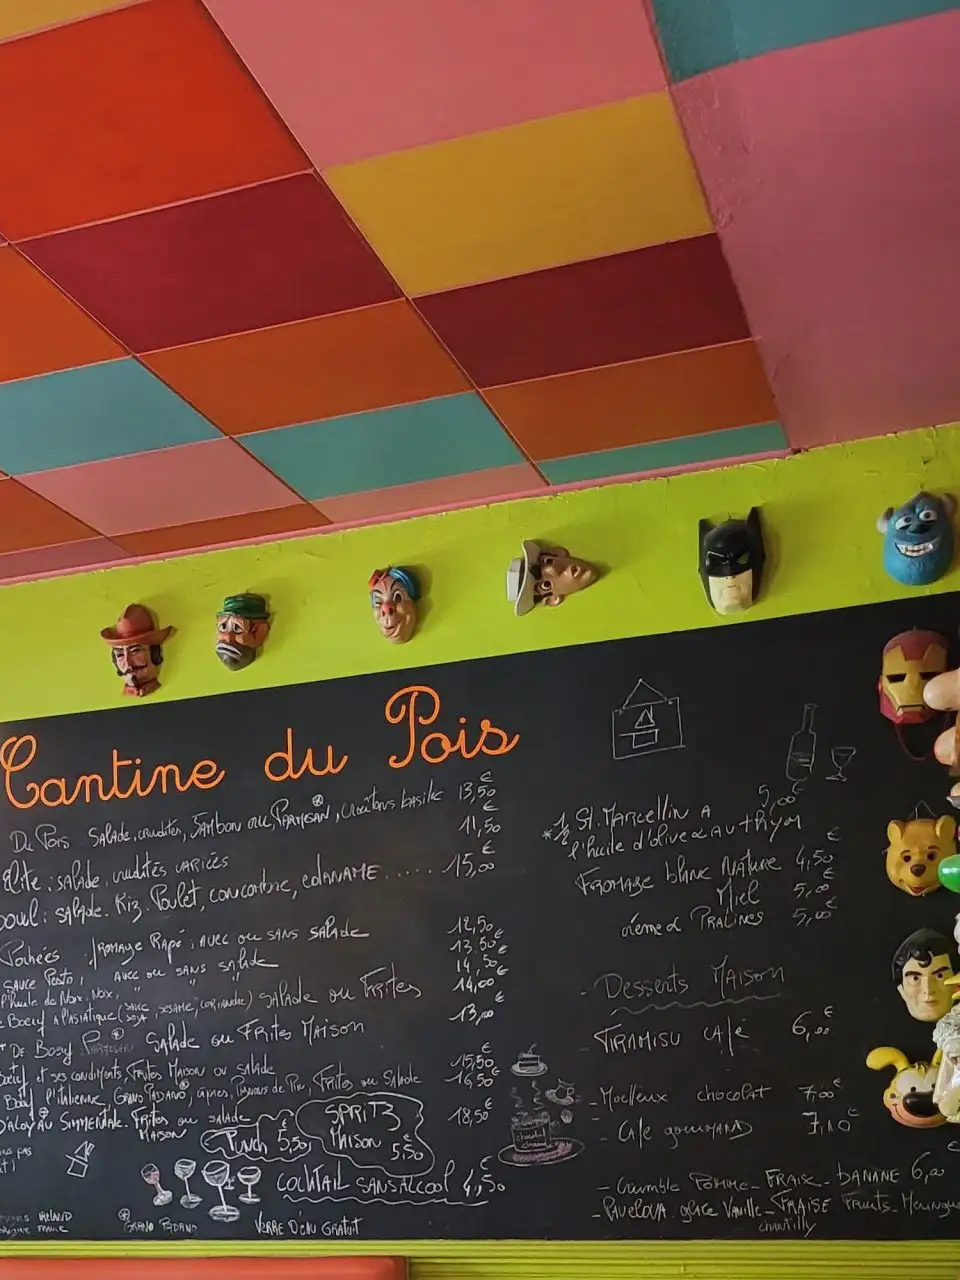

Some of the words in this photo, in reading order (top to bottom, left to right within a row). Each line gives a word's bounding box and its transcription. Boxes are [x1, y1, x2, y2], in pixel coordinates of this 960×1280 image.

[0, 735, 227, 809] Cantine
[264, 728, 348, 782] du
[384, 685, 520, 769] Pois
[593, 963, 690, 1000] Desserts
[696, 1082, 773, 1103] chocolat
